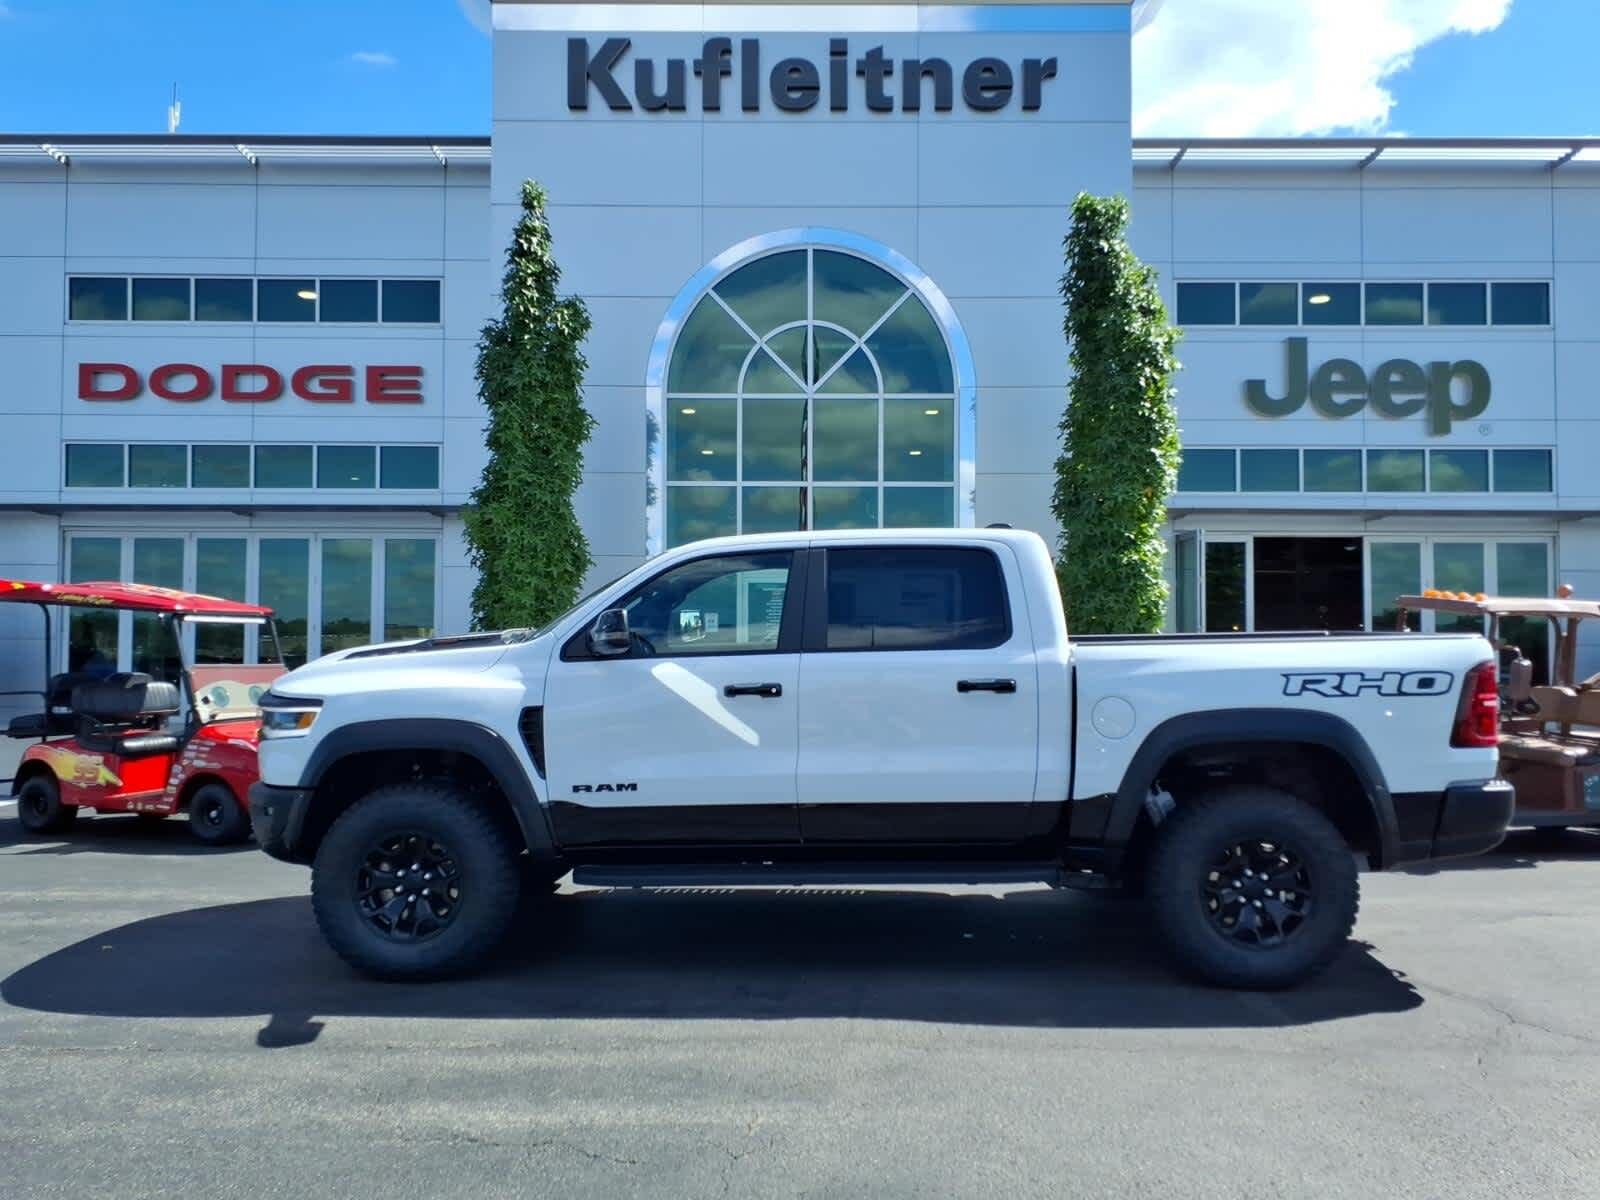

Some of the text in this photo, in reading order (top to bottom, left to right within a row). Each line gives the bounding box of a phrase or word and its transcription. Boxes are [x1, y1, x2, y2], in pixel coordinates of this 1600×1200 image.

[567, 37, 1058, 113] Kufleitner
[78, 362, 424, 403] DODGE
[1243, 336, 1492, 437] Jeep
[1280, 670, 1454, 697] RHO
[572, 783, 638, 793] RAM
